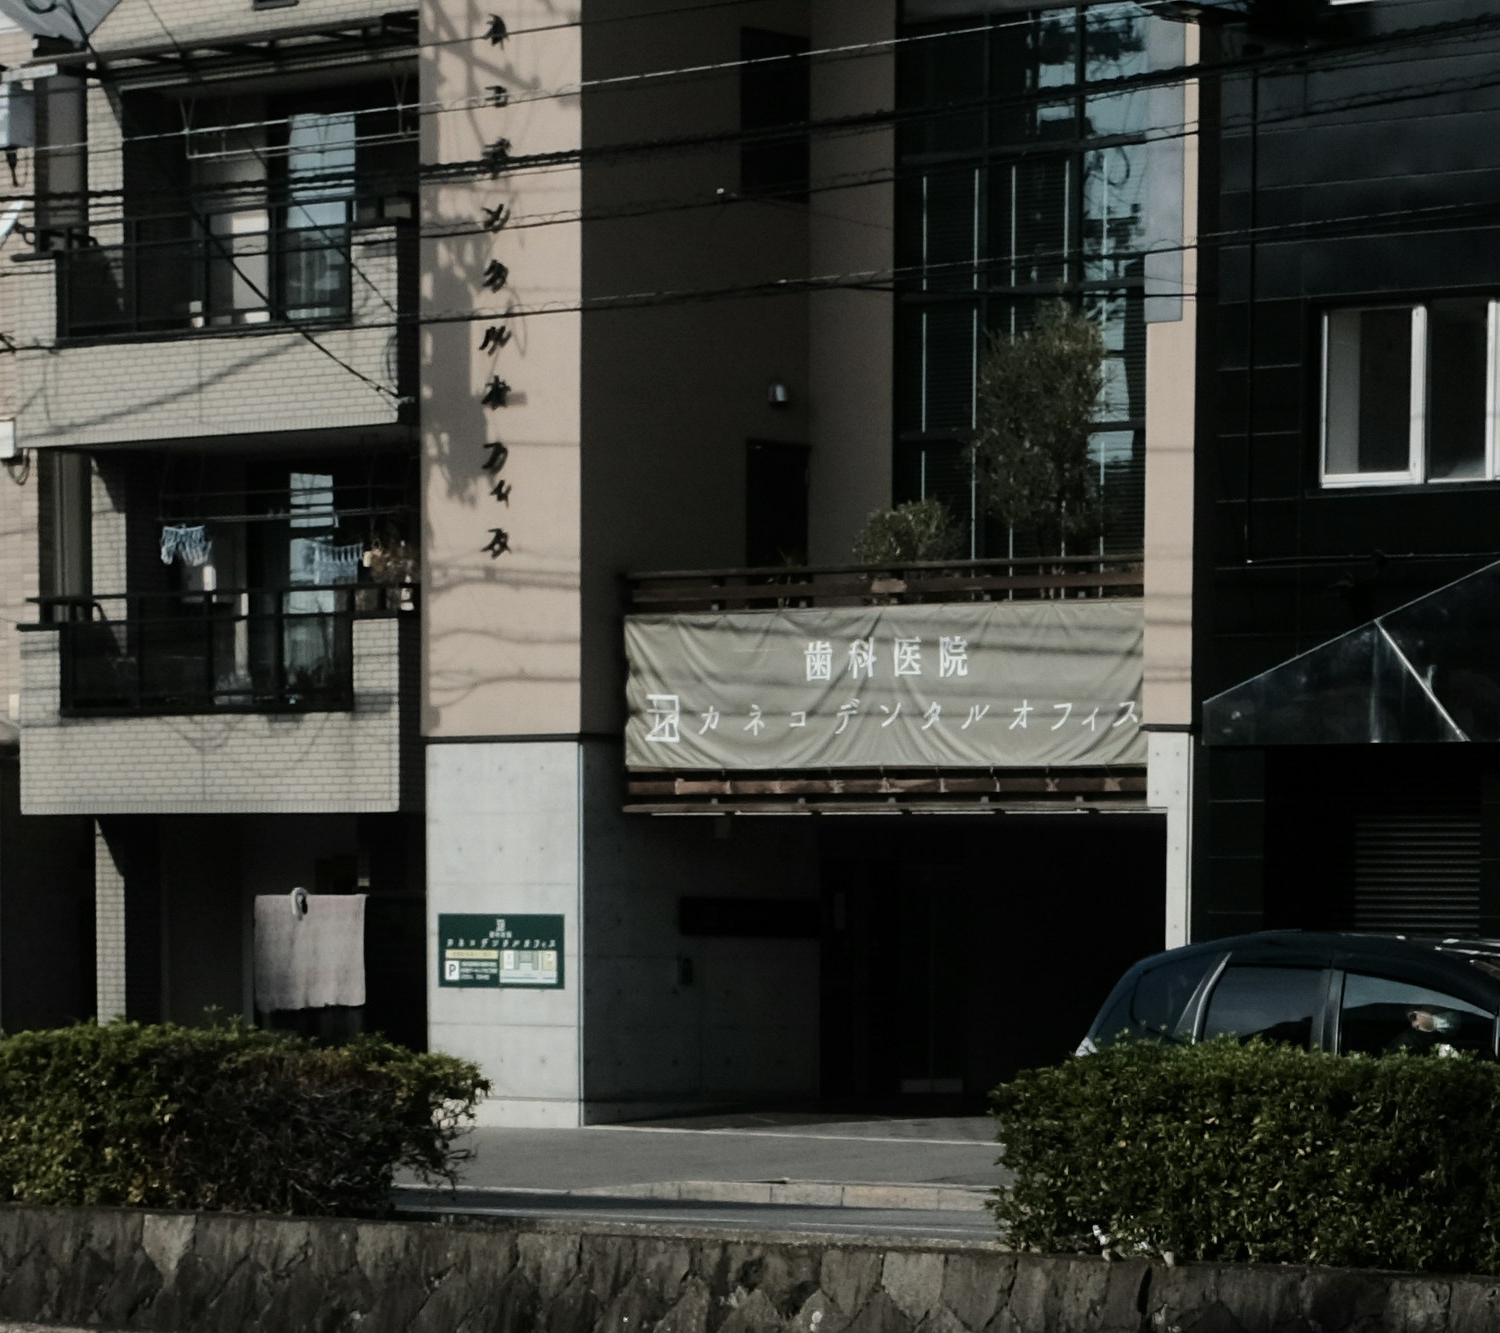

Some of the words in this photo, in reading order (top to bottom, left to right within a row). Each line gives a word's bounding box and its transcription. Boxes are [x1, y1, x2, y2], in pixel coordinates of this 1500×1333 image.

[803, 634, 970, 682] 歯科医院
[698, 697, 1140, 736] カネコデンタルオフィス
